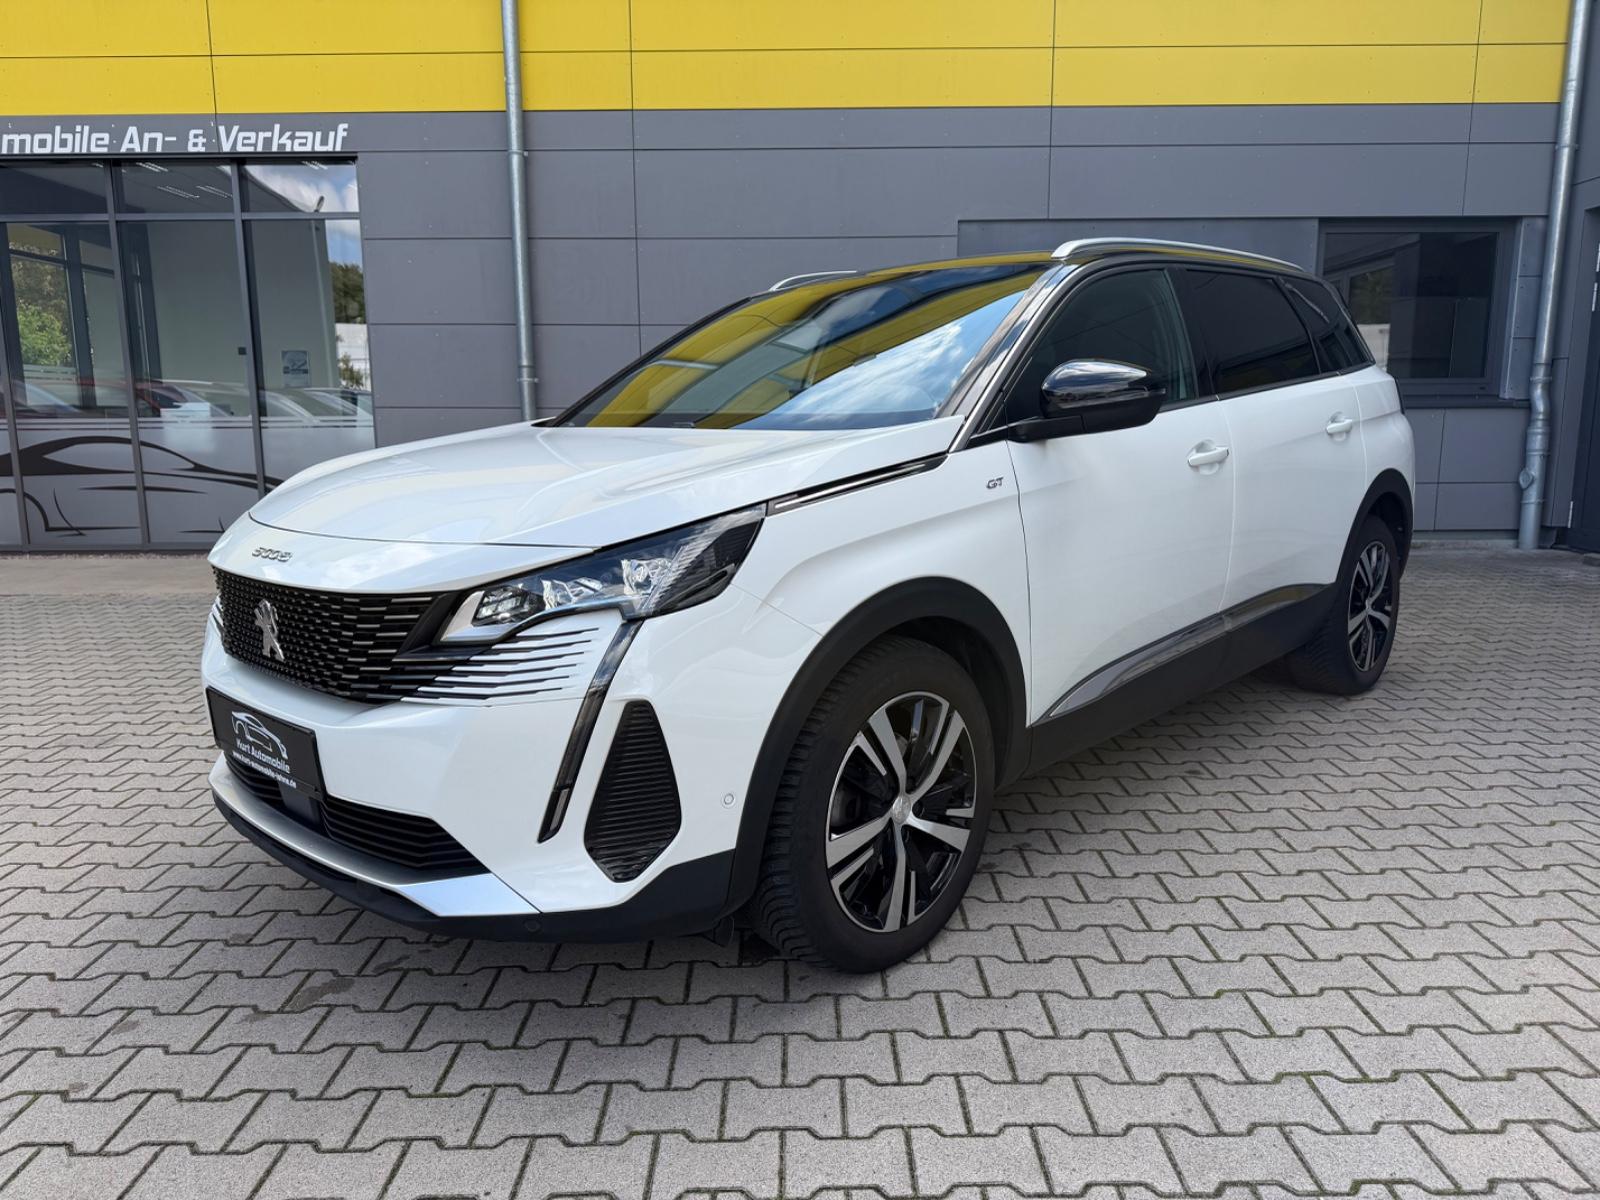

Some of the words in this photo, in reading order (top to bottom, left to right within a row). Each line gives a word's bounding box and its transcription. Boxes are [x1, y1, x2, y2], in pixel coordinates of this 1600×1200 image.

[1, 125, 110, 154] mobile
[120, 126, 177, 153] An-
[187, 129, 207, 153] &
[218, 123, 349, 152] Verkauf
[986, 476, 1004, 490] GT
[251, 746, 291, 774] Automobile
